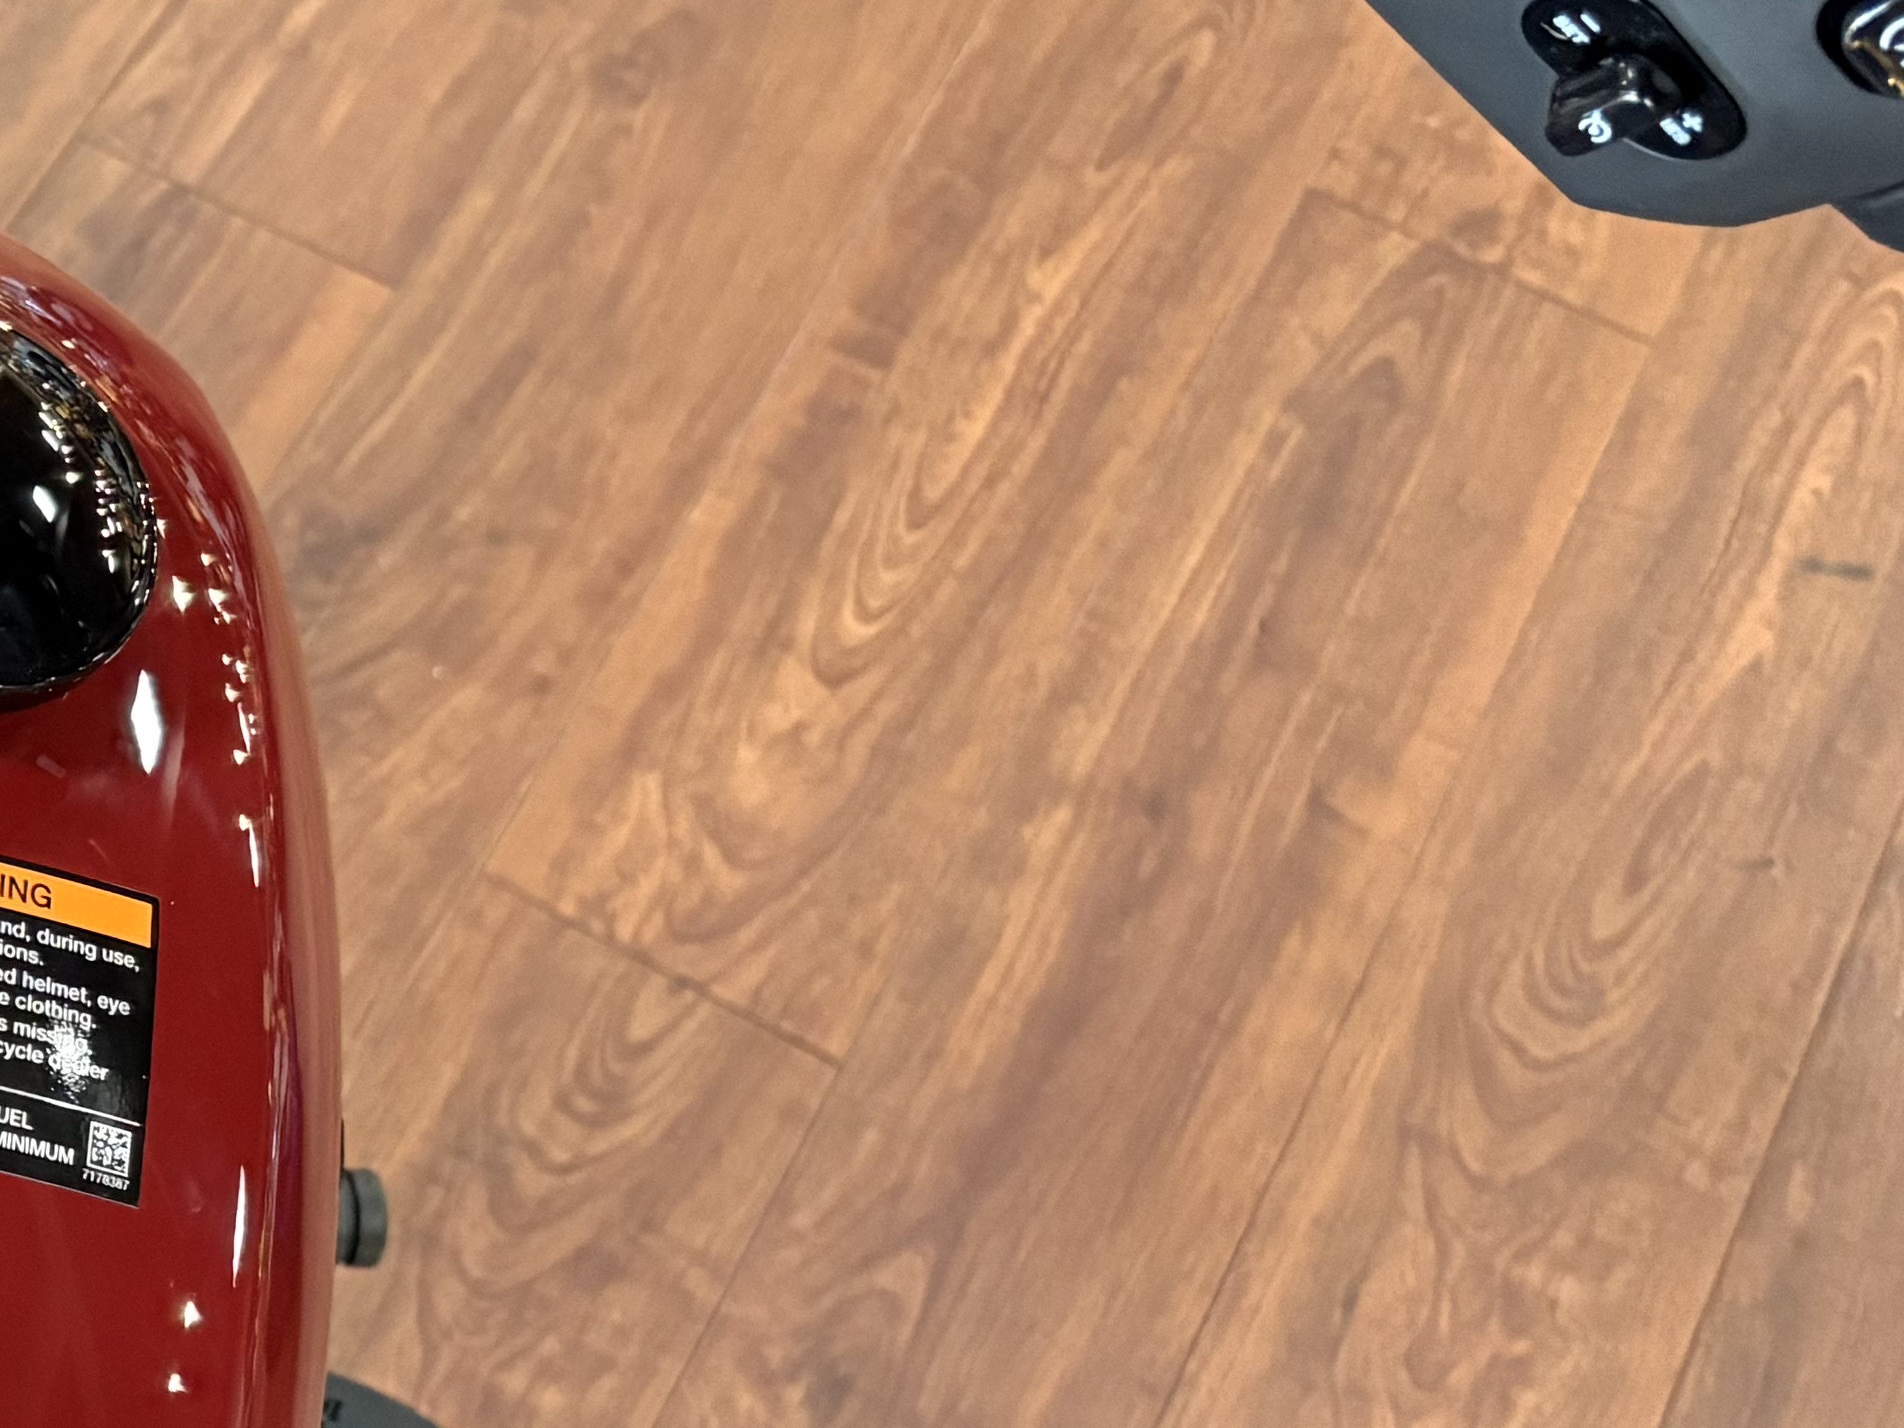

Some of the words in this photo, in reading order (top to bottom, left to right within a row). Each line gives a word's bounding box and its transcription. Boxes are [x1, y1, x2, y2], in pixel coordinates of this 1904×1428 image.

[36, 928, 98, 962] during
[101, 946, 141, 973] use,
[14, 994, 98, 1030] clothing.
[21, 970, 93, 1007] helmet,
[96, 994, 132, 1017] eye
